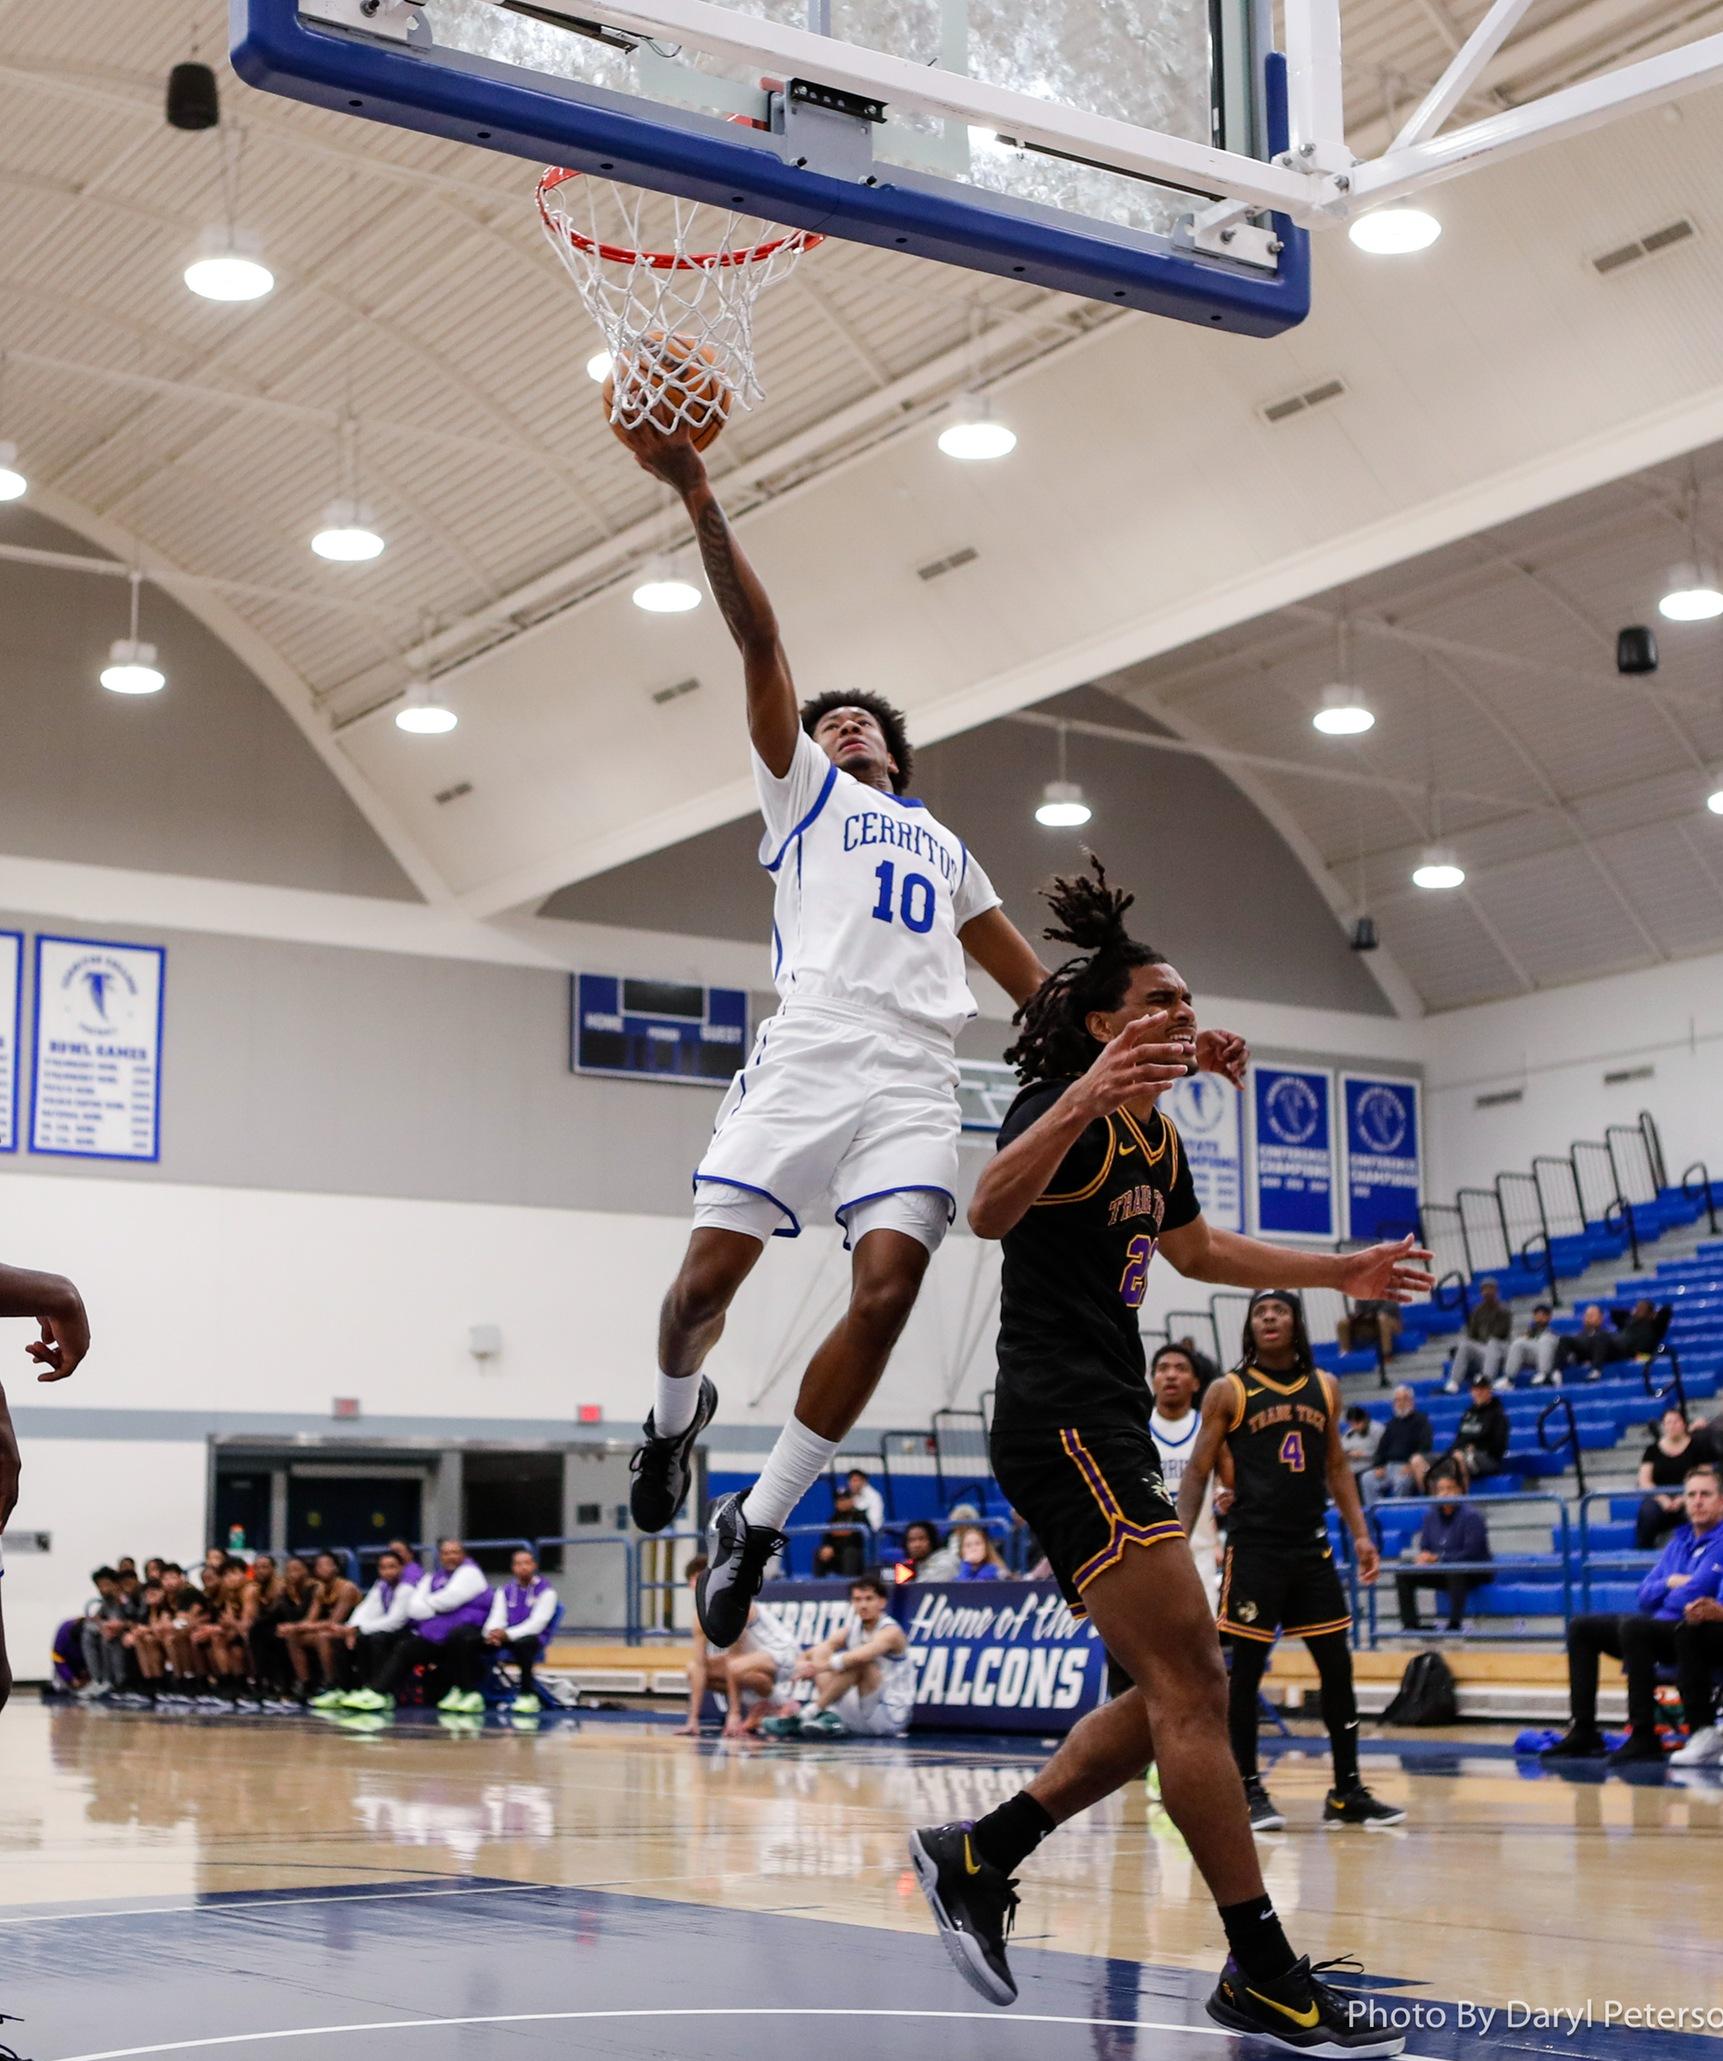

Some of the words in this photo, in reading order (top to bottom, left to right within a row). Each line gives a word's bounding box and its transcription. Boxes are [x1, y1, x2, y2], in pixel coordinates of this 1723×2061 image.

[872, 860, 936, 933] 10
[1119, 1234, 1159, 1308] 2
[1279, 1431, 1305, 1472] 4
[909, 1592, 996, 1643] Home
[994, 1590, 1039, 1642] of
